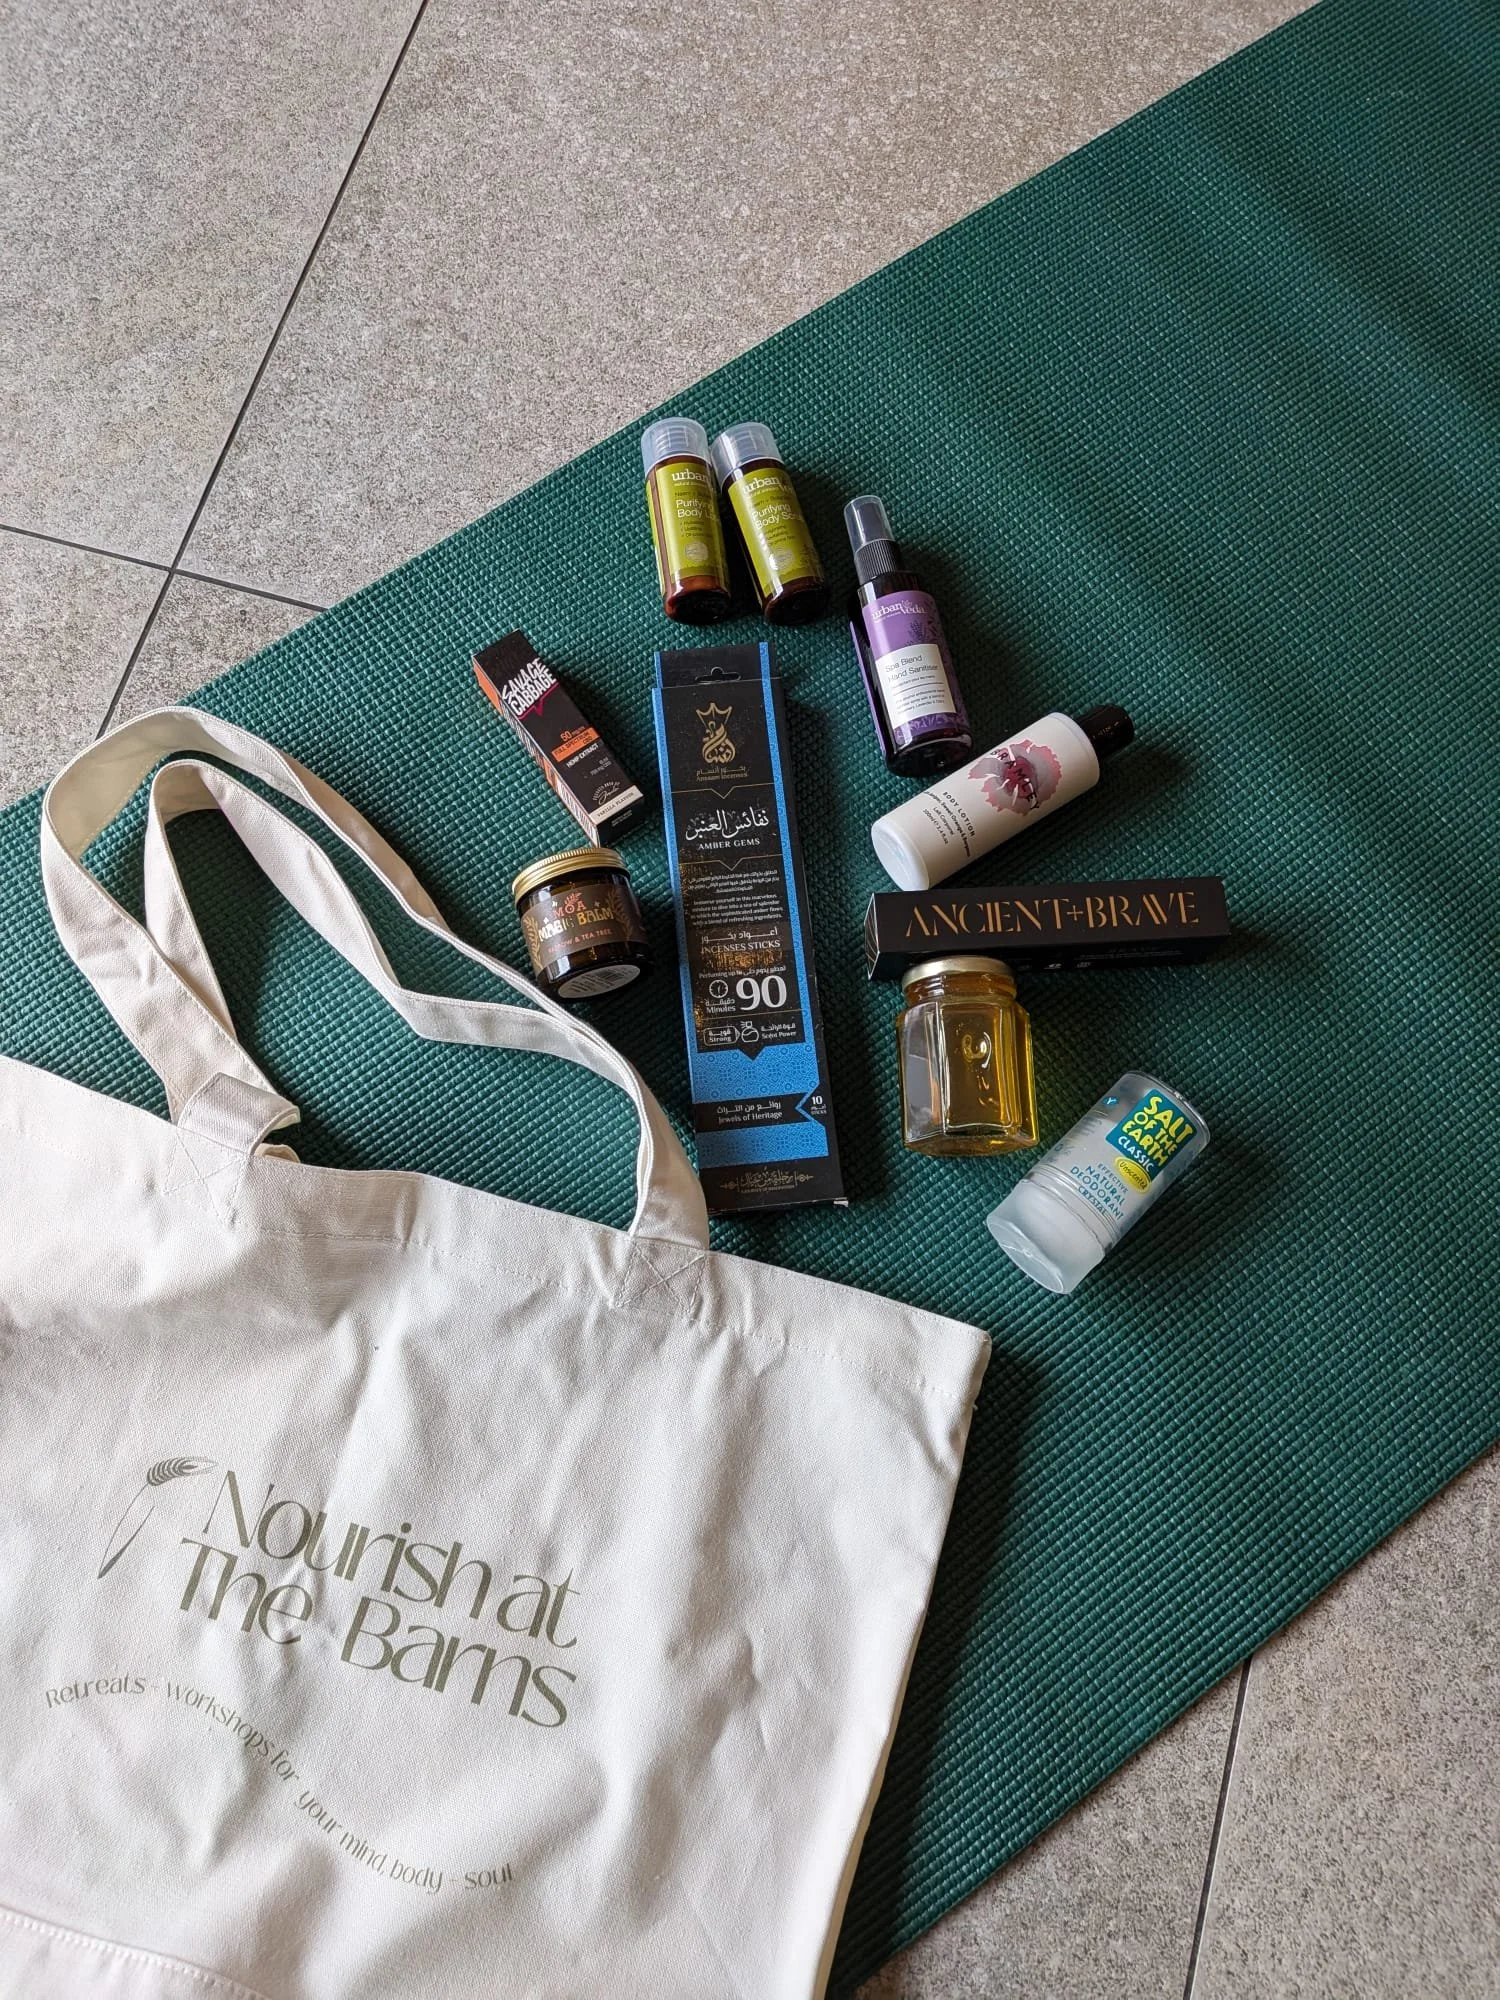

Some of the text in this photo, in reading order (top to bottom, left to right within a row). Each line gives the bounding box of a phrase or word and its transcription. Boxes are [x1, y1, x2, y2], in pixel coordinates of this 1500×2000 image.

[671, 469, 708, 484] urban
[743, 476, 779, 494] urban
[677, 508, 703, 520] Body
[751, 503, 791, 520] Purifying
[755, 515, 780, 530] Body
[871, 603, 903, 620] urban
[885, 655, 922, 673] Spa Blend
[501, 657, 549, 704] SAVAGE
[511, 668, 557, 716] CABBAGE
[566, 743, 599, 768] HEMP EXTRACT
[990, 750, 1040, 810] BRAMLEY
[685, 806, 769, 841] نفائس العنبر
[943, 792, 976, 837] BODY LOTION
[698, 838, 761, 850] AMBER GEMS
[577, 907, 614, 925] BALM
[906, 891, 1199, 937] ANCIENT+BRAVE
[582, 932, 594, 941] TEA
[701, 939, 781, 955] INCENSES STICKS
[735, 974, 788, 1012] 90
[706, 1004, 736, 1014] Minutes
[709, 1035, 732, 1043] Strong
[812, 1096, 823, 1105] 10
[718, 1111, 783, 1124] Jewels of Heritage
[1144, 1096, 1193, 1143] SALT
[1122, 1120, 1168, 1166] EARTH
[1133, 1111, 1178, 1155] OF THE
[1118, 1136, 1154, 1172] CLASSIC
[1070, 1166, 1124, 1221] DEODORANT
[1086, 1165, 1125, 1206] NATURAL
[1098, 1163, 1129, 1194] EFFECTIVE
[1078, 1186, 1107, 1216] CRYSTAL
[202, 1470, 581, 1648] Nourish at
[179, 1537, 578, 1729] The Barns
[45, 1672, 147, 1709] Retreats
[271, 1750, 300, 1782] for
[293, 1790, 343, 1835] your
[339, 1832, 388, 1876] mind,
[390, 1859, 443, 1895] body
[464, 1863, 513, 1891] soul
